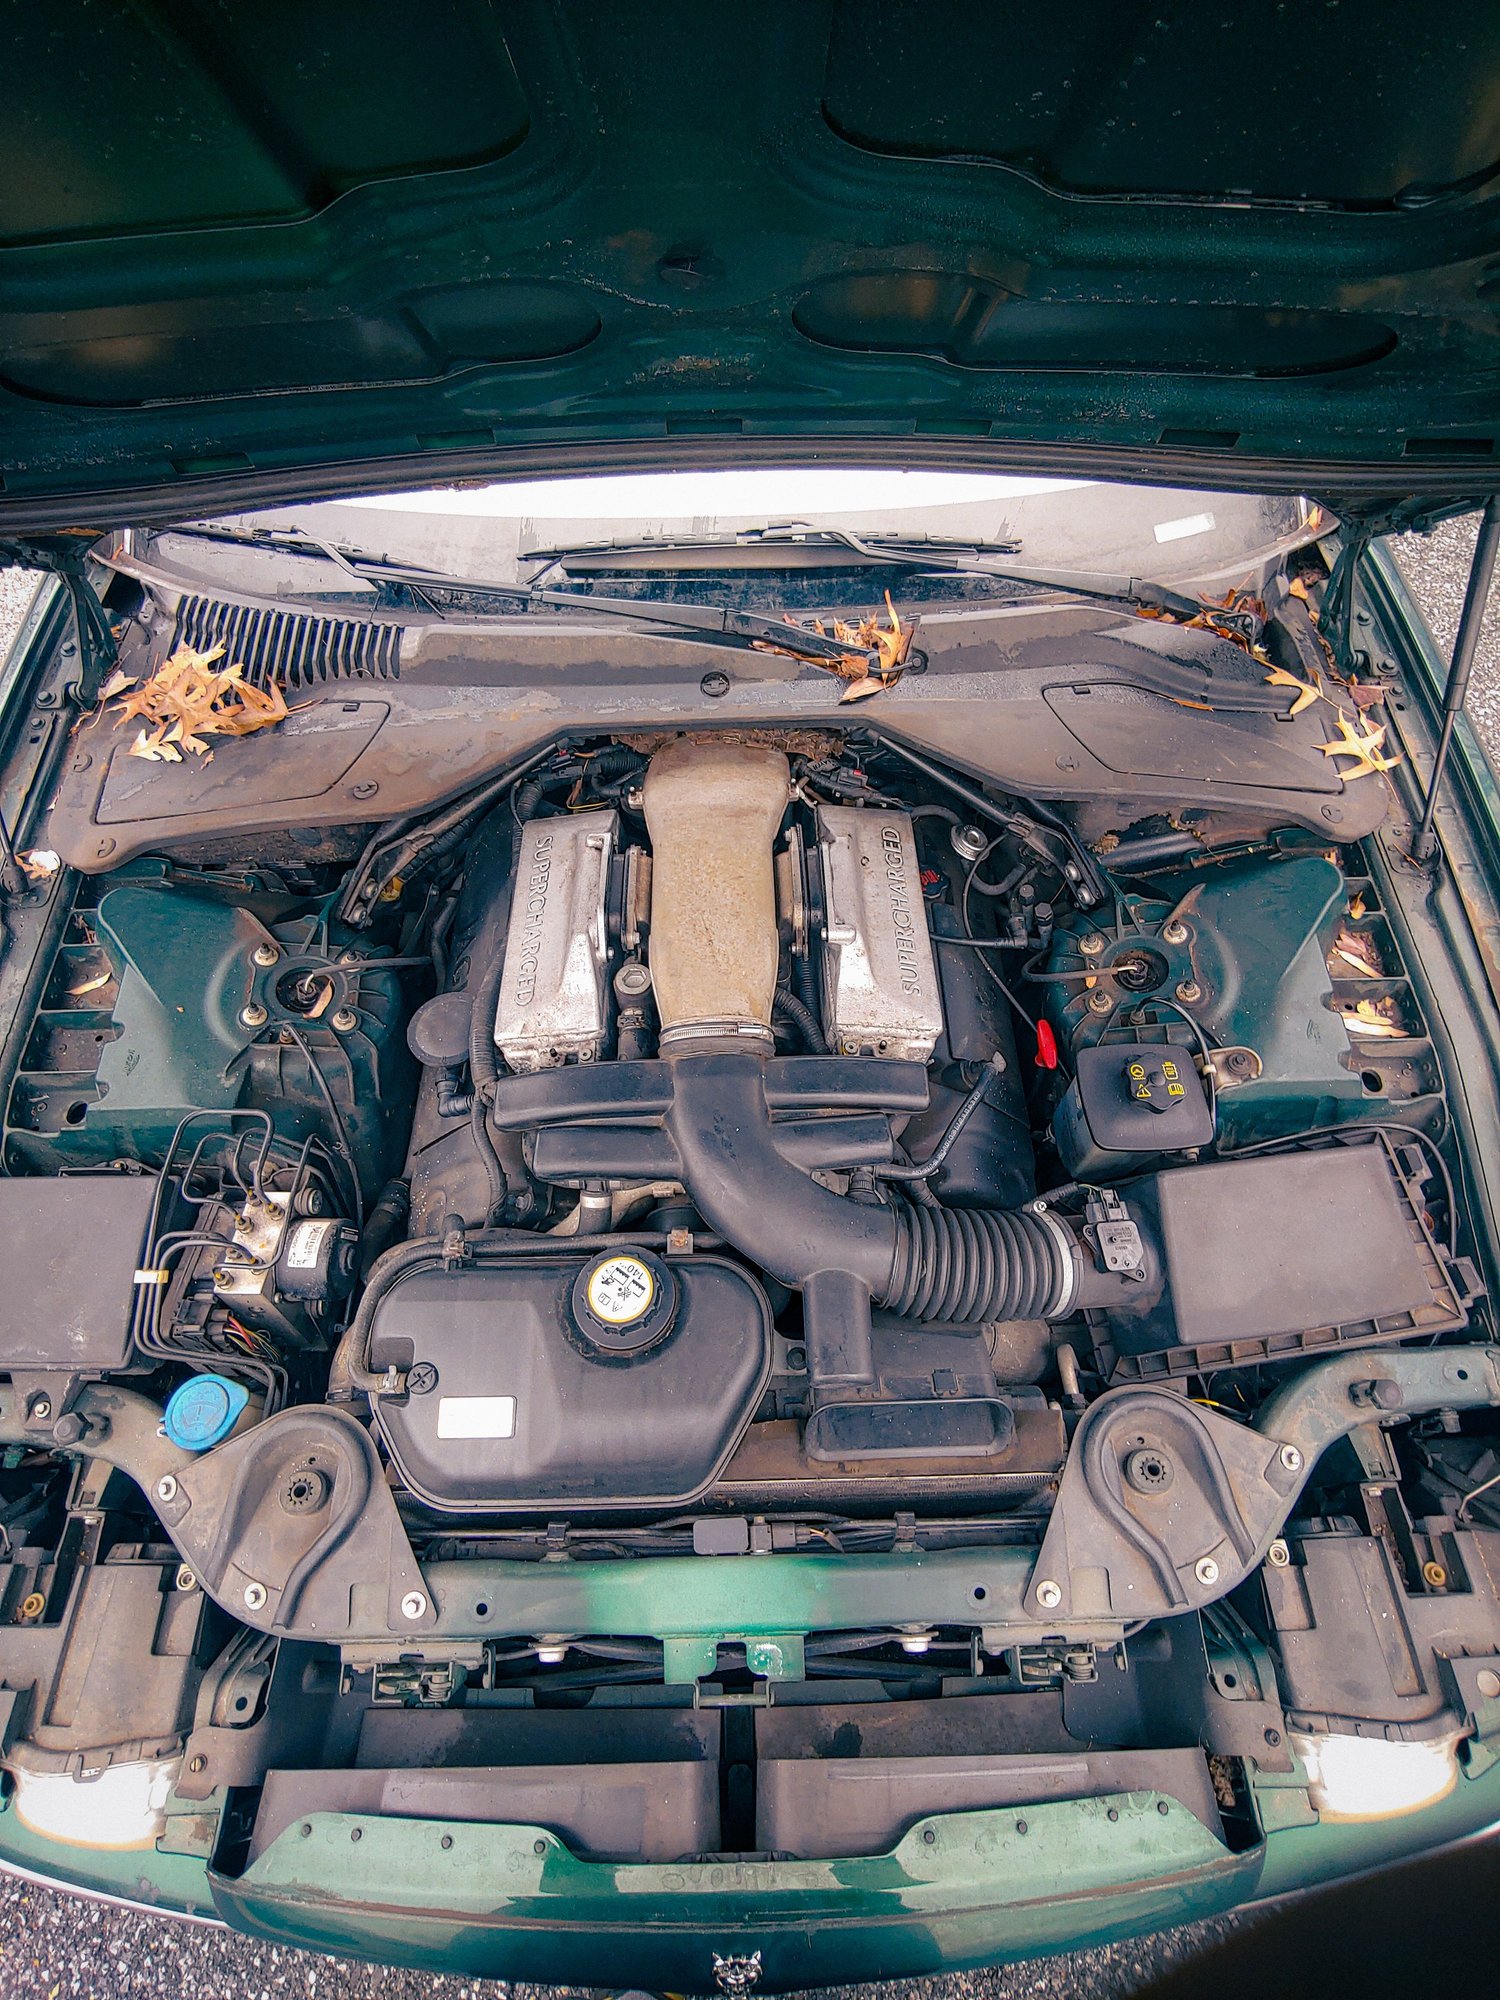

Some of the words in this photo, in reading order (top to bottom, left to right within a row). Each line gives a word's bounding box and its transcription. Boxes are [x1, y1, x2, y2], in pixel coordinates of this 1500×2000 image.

[514, 835, 554, 1007] SUPERCHARGED
[881, 825, 922, 998] SUPERCHARGED
[627, 1264, 644, 1280] 140
